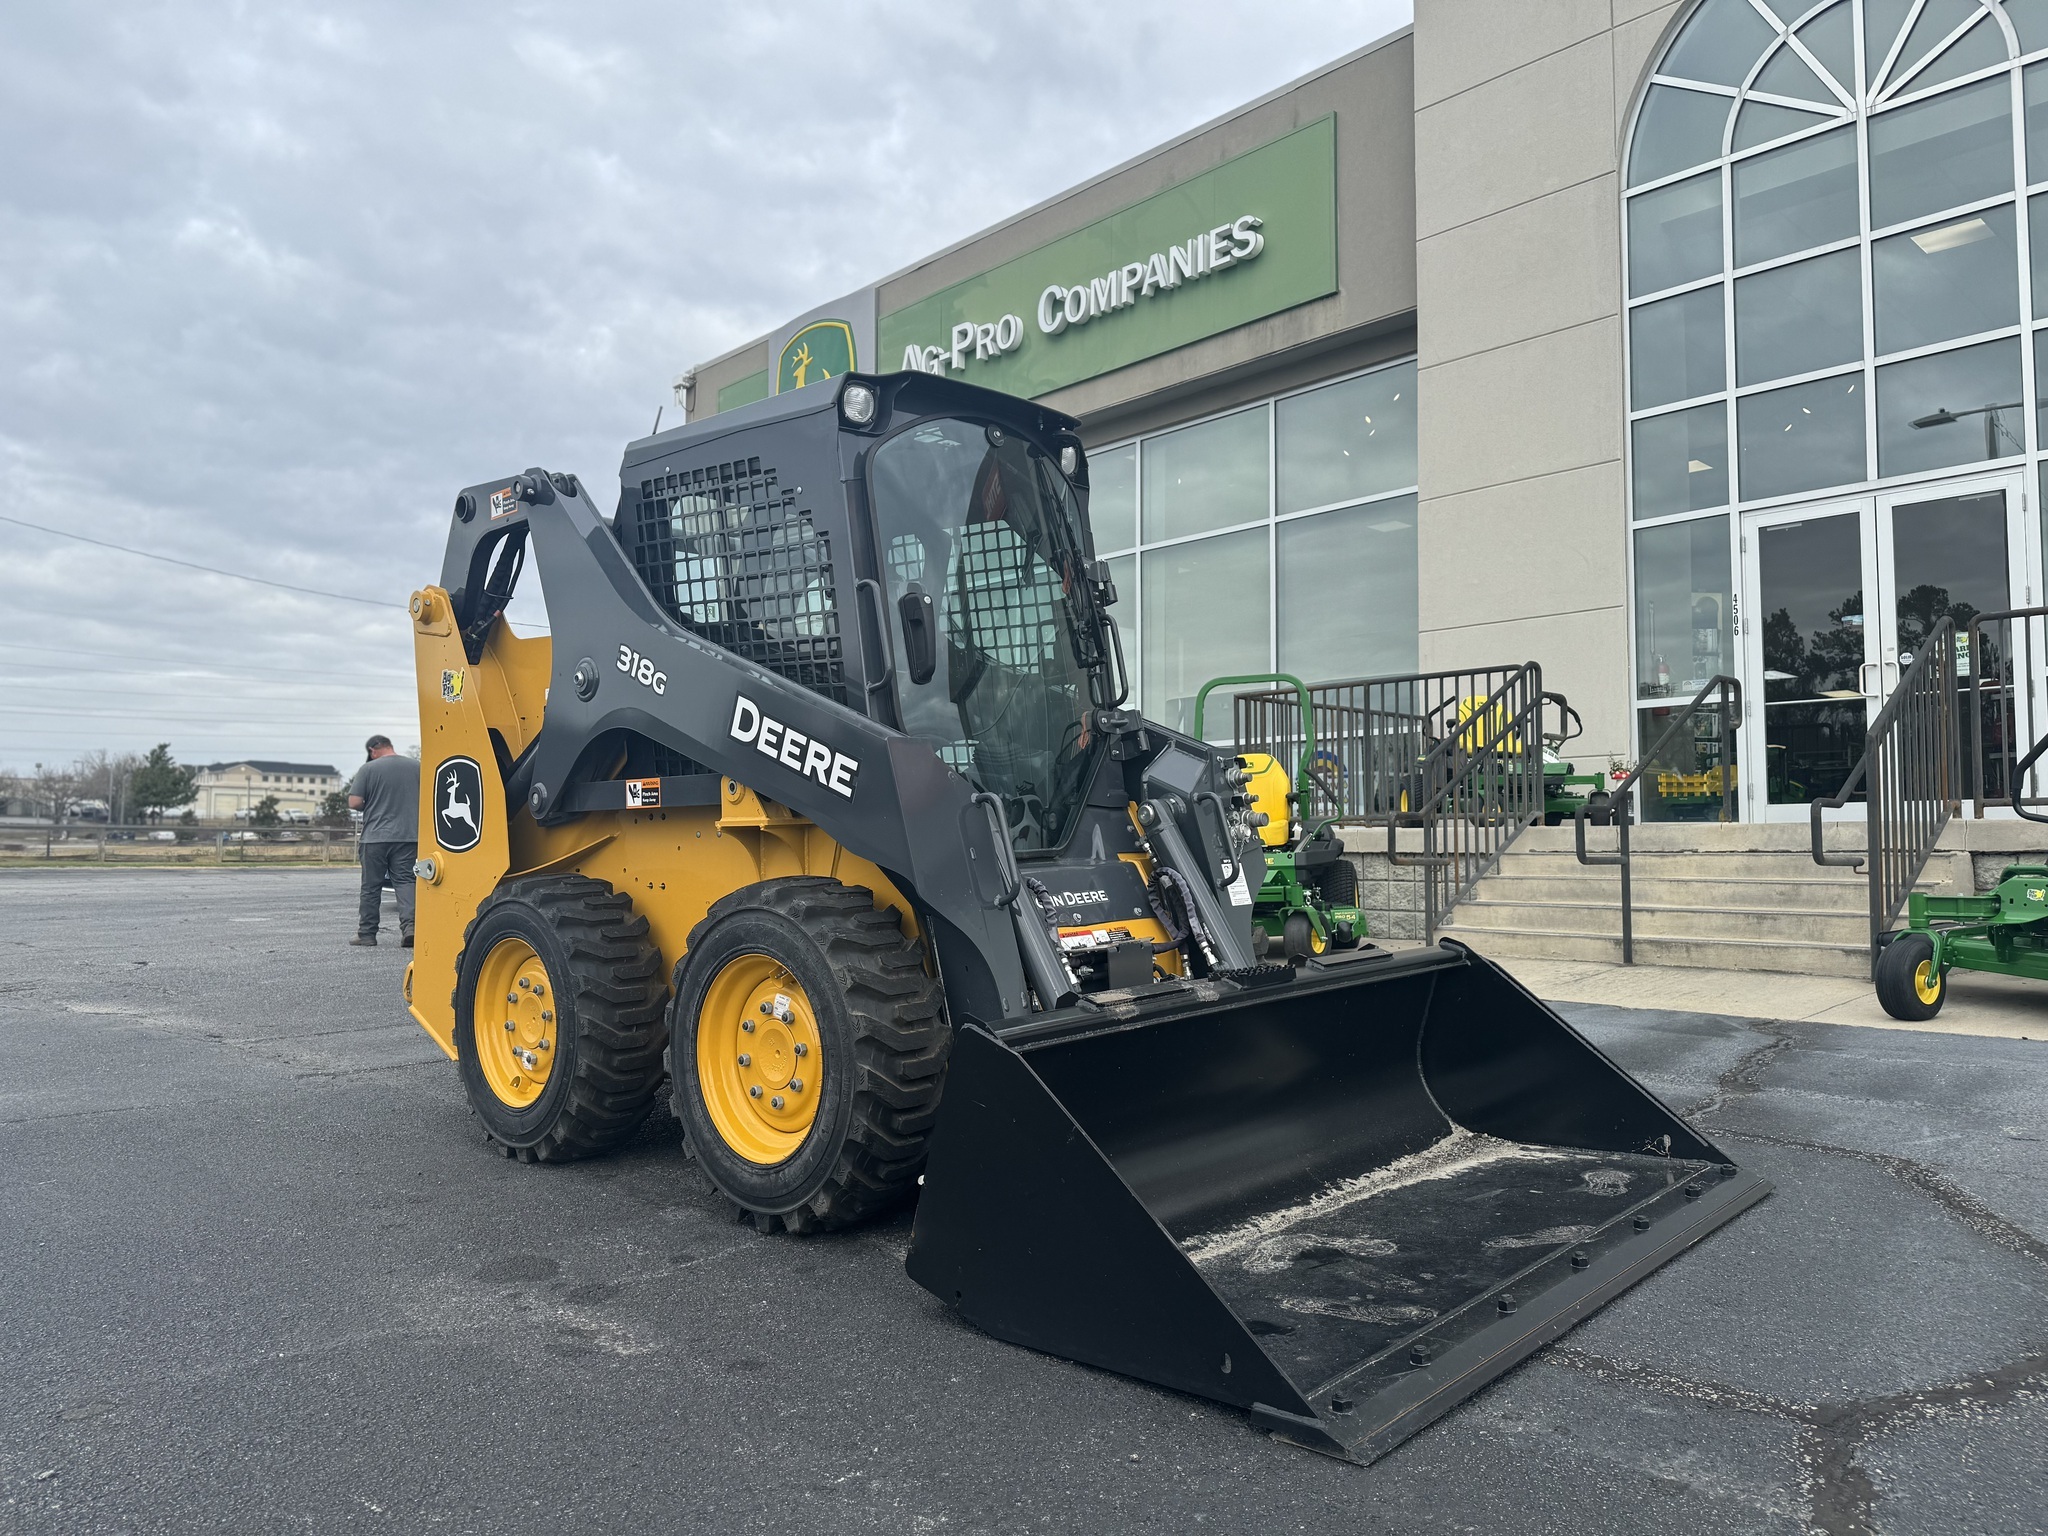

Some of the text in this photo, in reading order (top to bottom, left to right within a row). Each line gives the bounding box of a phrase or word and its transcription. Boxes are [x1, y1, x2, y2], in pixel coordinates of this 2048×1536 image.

[1037, 214, 1265, 335] COMPANIES
[615, 644, 668, 696] 318G
[730, 695, 859, 799] DEERE
[1063, 889, 1109, 906] DEERE
